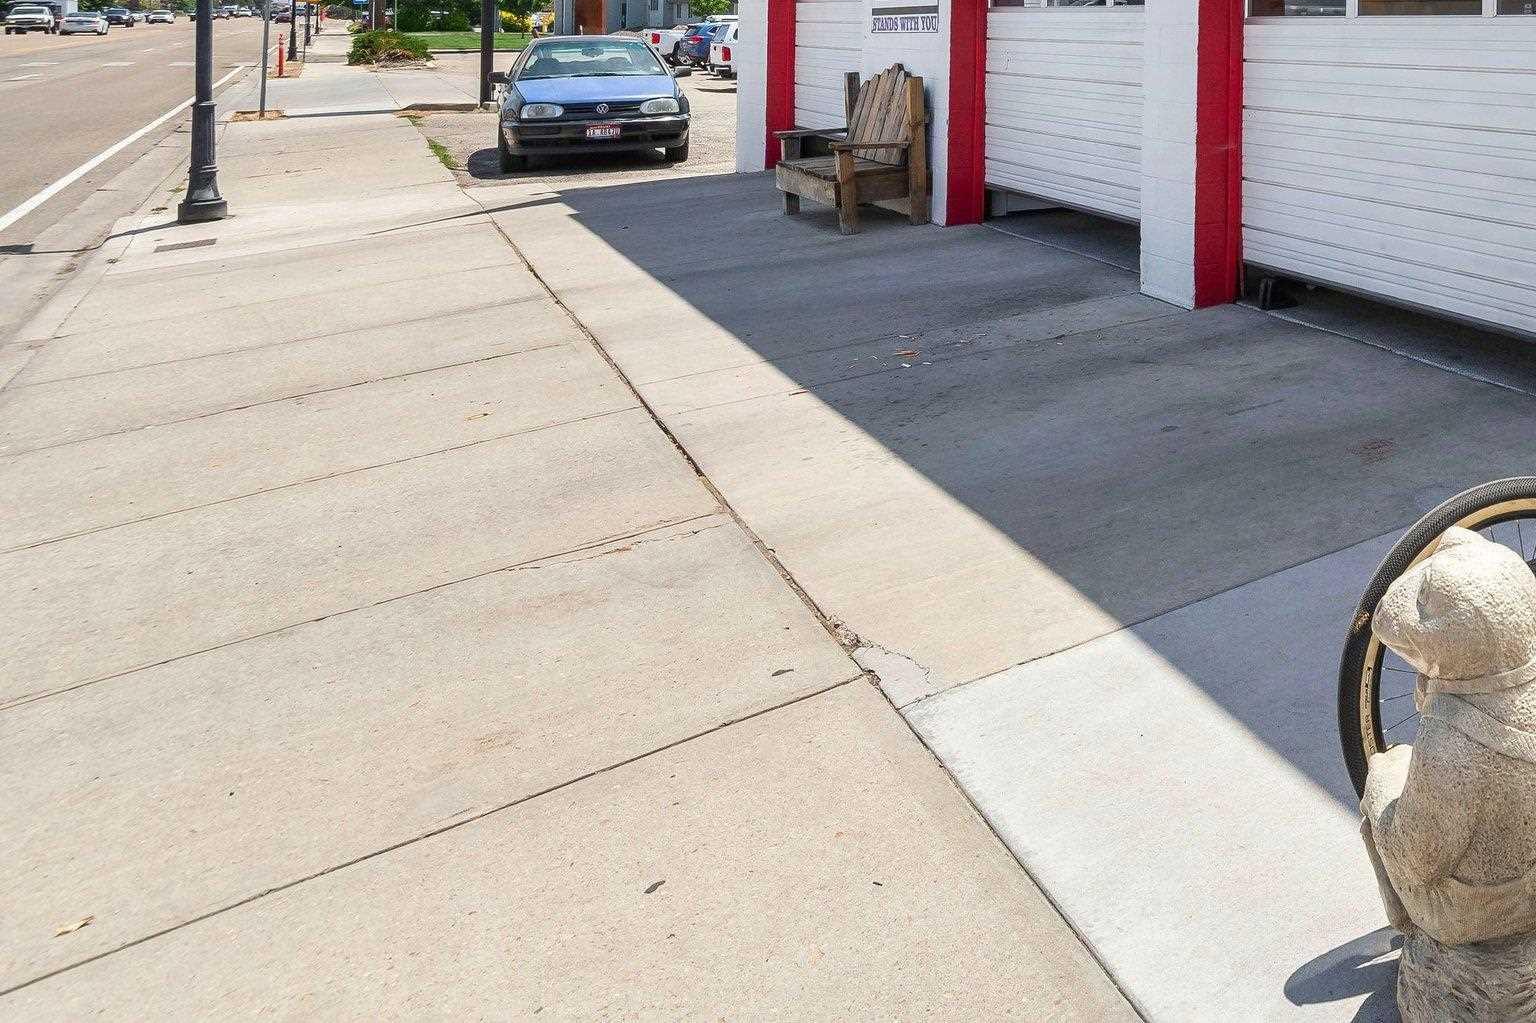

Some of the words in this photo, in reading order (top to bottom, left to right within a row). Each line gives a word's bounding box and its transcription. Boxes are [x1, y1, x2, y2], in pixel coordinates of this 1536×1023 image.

[872, 16, 898, 32] STANDS
[899, 16, 919, 32] WITH
[920, 15, 936, 31] YOU
